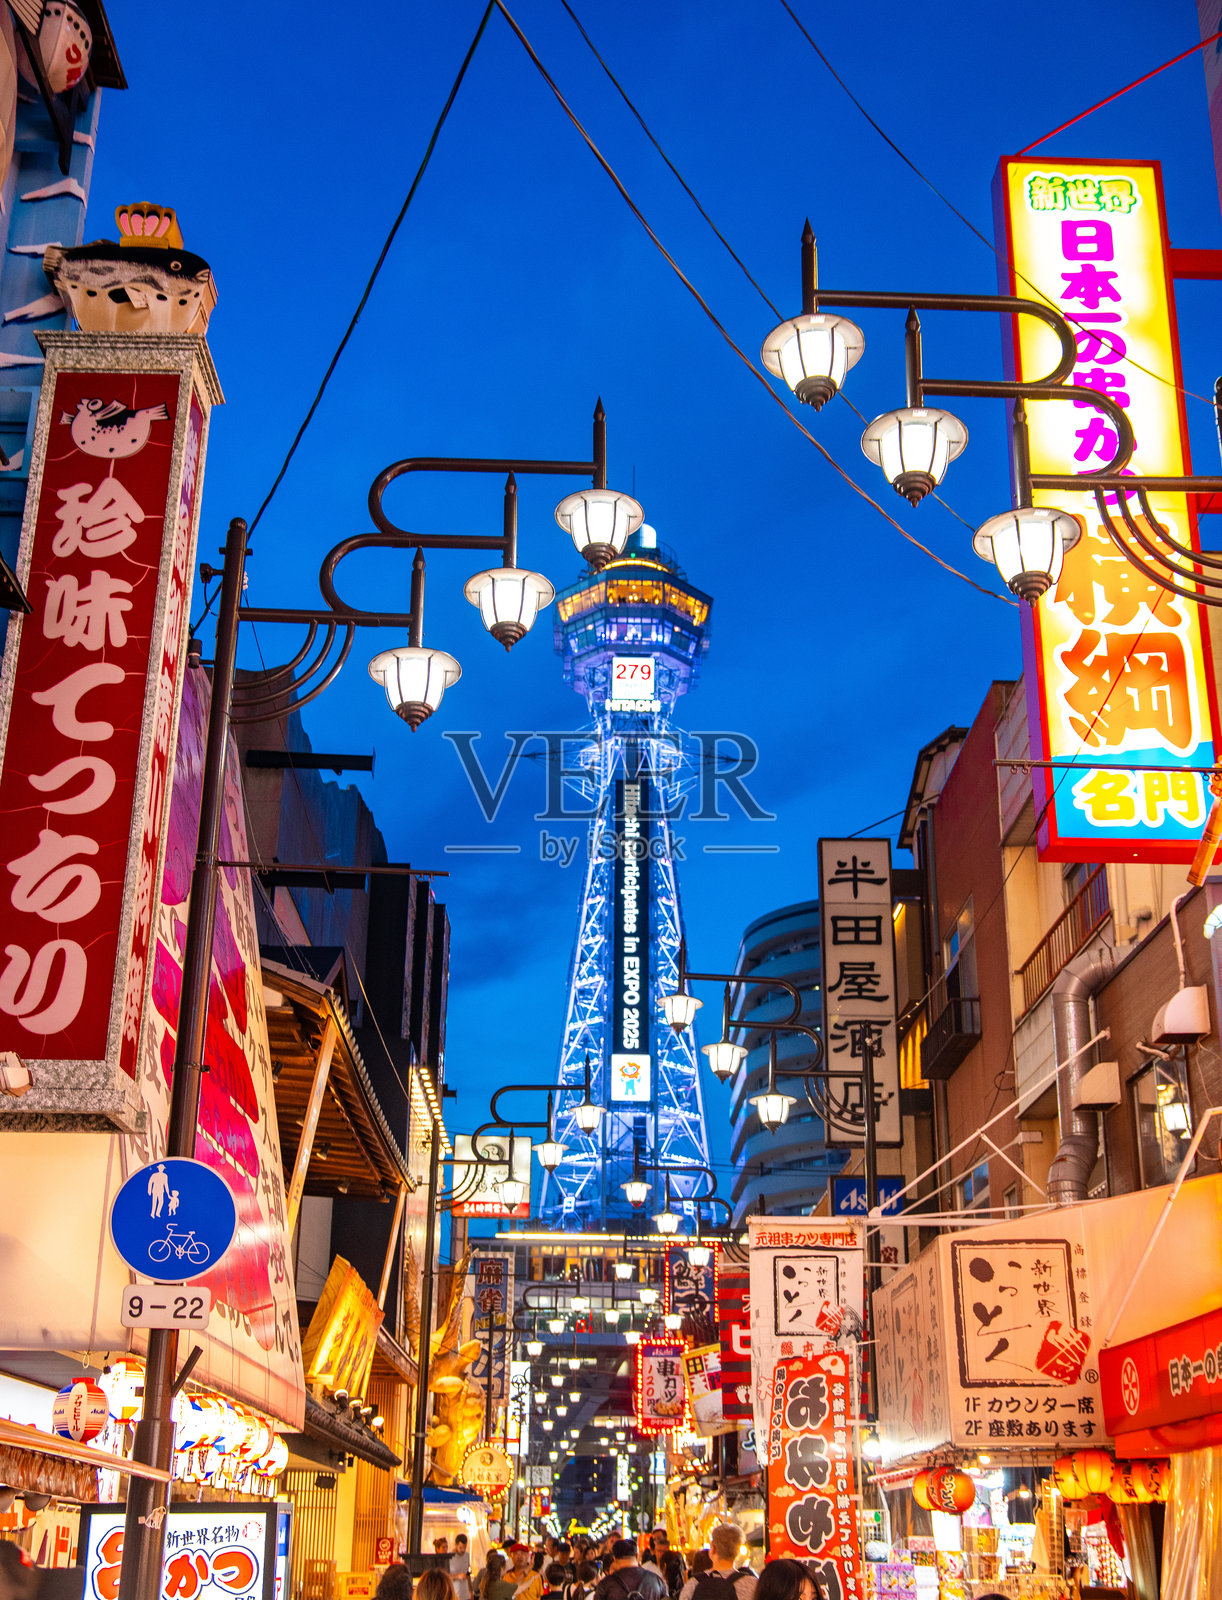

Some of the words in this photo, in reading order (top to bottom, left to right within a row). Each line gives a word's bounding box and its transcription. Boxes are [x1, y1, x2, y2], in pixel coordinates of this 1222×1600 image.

[1028, 175, 1137, 214] 新世界
[616, 664, 652, 680] 279
[605, 699, 661, 712] HITACHI
[623, 784, 641, 841] Hitachi
[1083, 771, 1199, 821] 名門
[620, 844, 641, 933] participates
[623, 938, 640, 953] in
[623, 956, 640, 1004] EXPO
[828, 855, 894, 1123] 半田屋酒店
[622, 1007, 640, 1050] 2025
[840, 1188, 897, 1211] Ashi
[755, 1232, 857, 1247] 元祖串カツ専門店
[477, 1260, 504, 1313] 麻雀
[657, 1359, 677, 1402] 串カツ
[72, 1394, 83, 1432] アサヒビール
[965, 1397, 980, 1412] 1F
[988, 1397, 1094, 1414] カウンター席
[965, 1421, 983, 1436] 2F
[988, 1421, 1097, 1437] 座敷あります
[167, 1526, 239, 1548] 新世界名物
